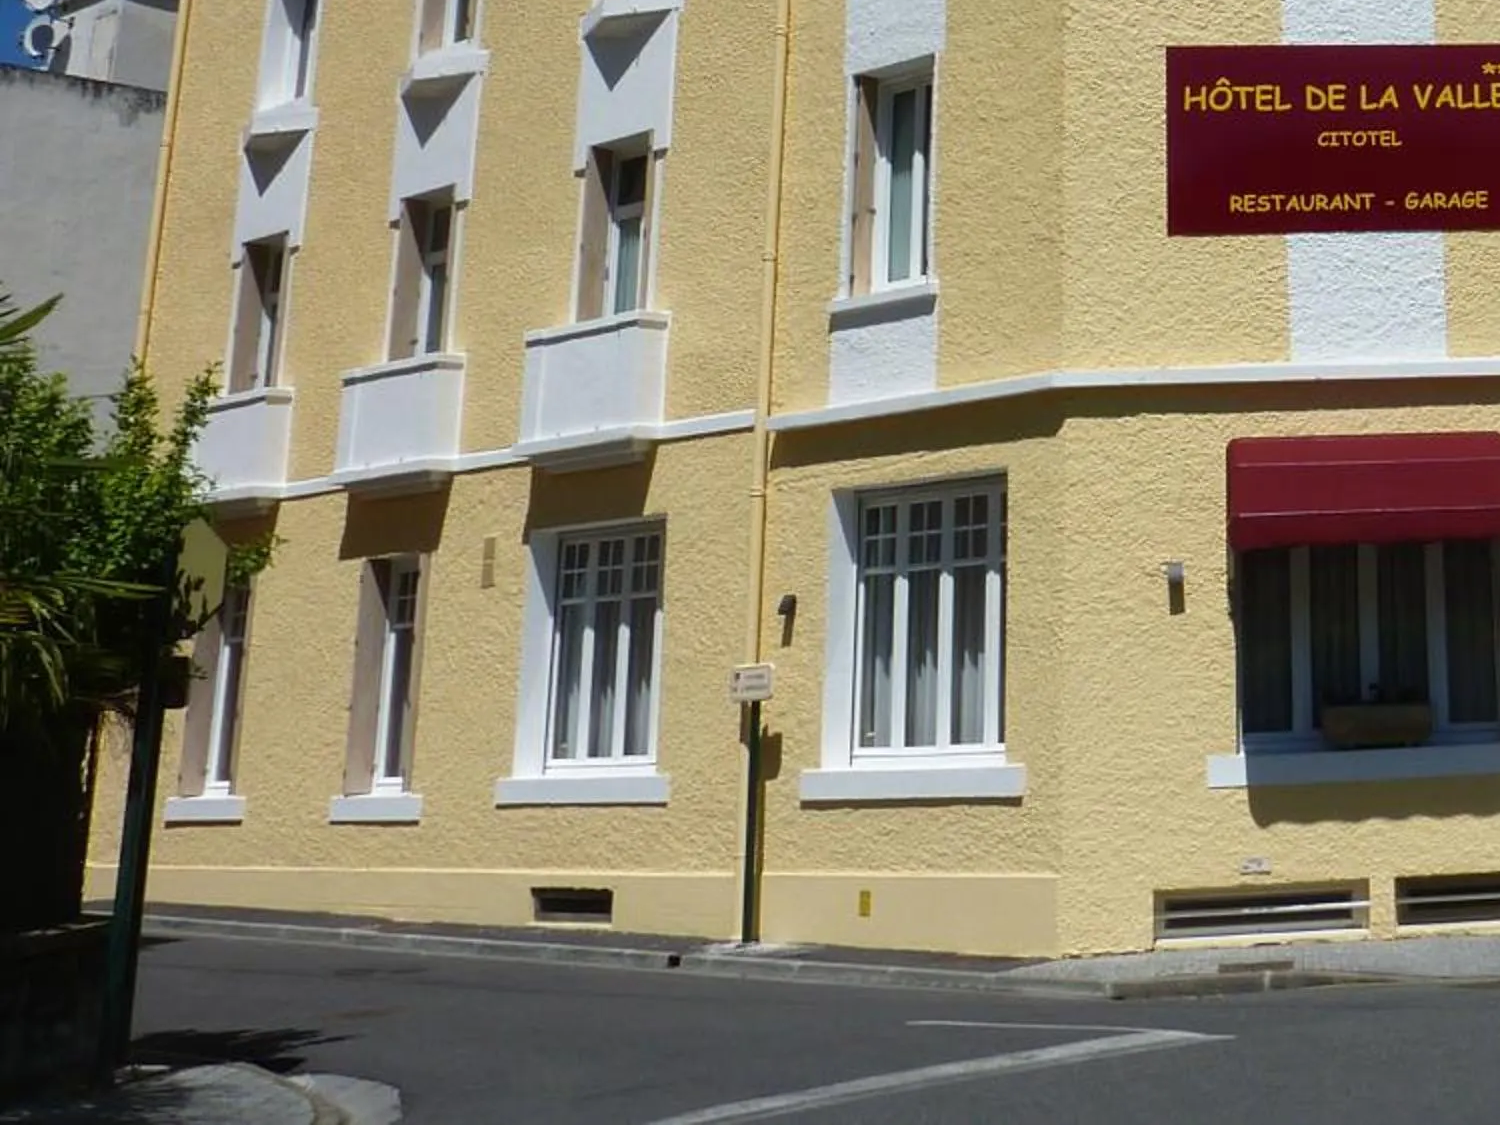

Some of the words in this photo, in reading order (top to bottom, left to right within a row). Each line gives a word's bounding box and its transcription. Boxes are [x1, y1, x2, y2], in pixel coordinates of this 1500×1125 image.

[1183, 77, 1293, 112] HÔTEL
[1305, 84, 1347, 111] DE
[1359, 84, 1399, 111] LA
[1317, 130, 1403, 147] CITOTEL
[1229, 193, 1376, 213] RESTAURANT
[1404, 190, 1489, 210] GARAGE
